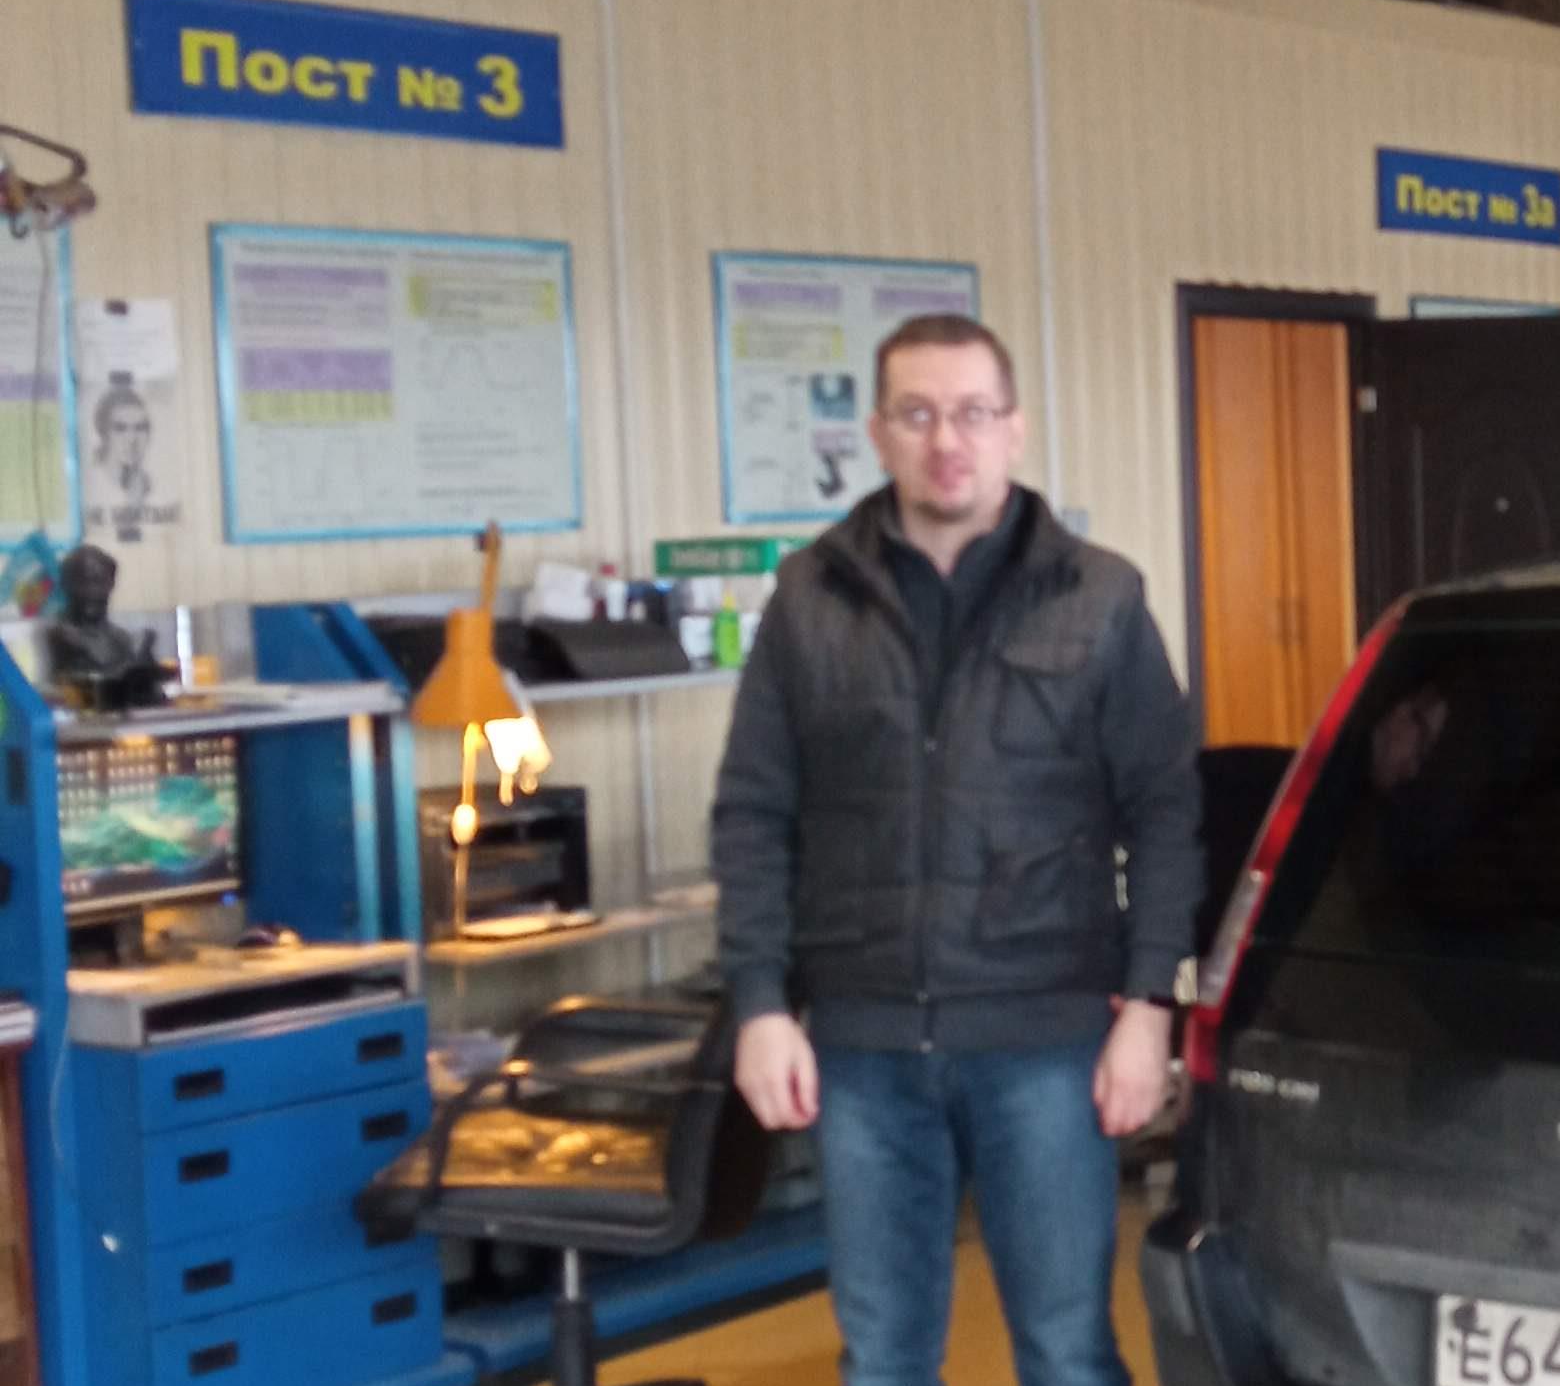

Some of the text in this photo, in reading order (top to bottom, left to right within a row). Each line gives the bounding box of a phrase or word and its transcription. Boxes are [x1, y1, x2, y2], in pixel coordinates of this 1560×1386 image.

[179, 28, 525, 118] Пост № 3
[1396, 174, 1481, 221] Пост
